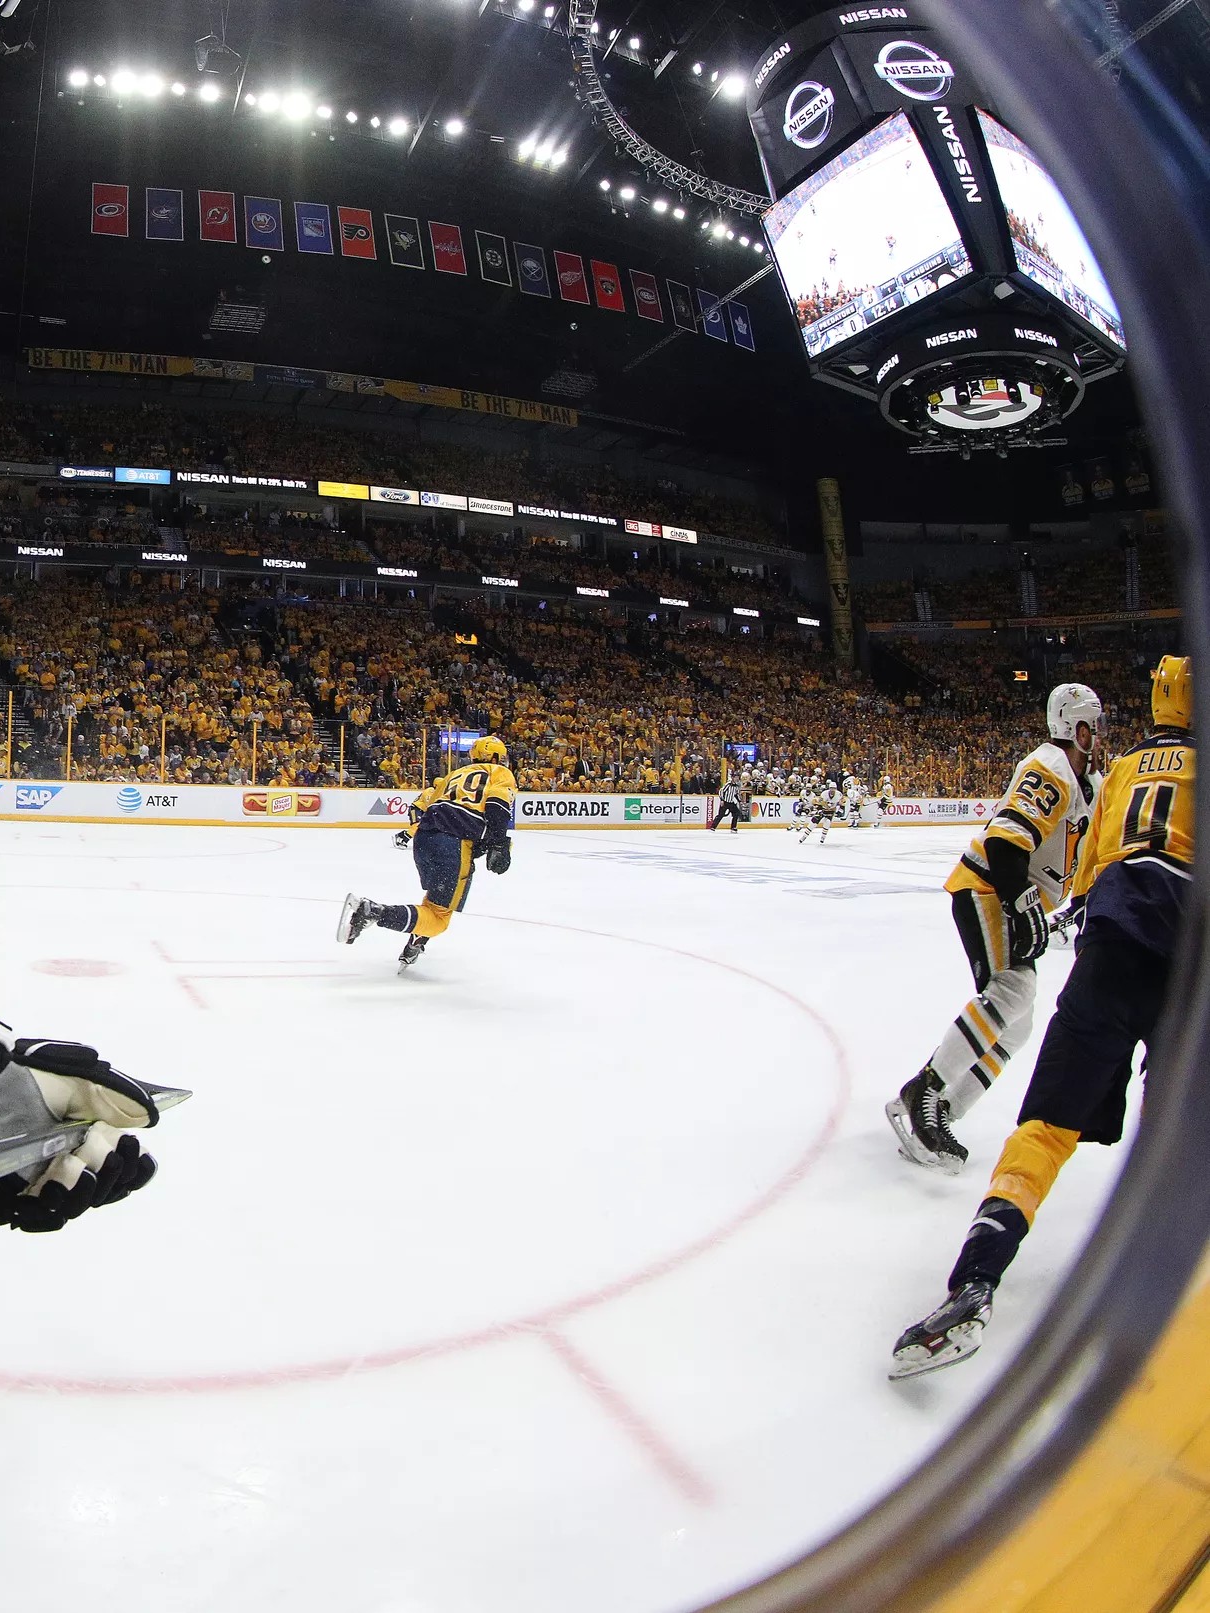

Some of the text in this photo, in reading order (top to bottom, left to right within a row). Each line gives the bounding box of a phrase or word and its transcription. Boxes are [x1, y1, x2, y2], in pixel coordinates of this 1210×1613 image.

[839, 7, 907, 25] NISSAN
[754, 42, 792, 89] NISSAN
[884, 63, 946, 76] NISSAN
[788, 95, 829, 134] NISSAN
[933, 106, 982, 203] NISSAN
[905, 256, 942, 281] PENGUINS
[913, 285, 921, 298] 1
[871, 299, 897, 319] 12:14
[820, 306, 855, 332] PREDATORS
[850, 319, 857, 333] 0
[926, 328, 978, 348] NISSAN
[1014, 328, 1058, 347] NISSAN
[32, 350, 168, 375] BE THE 7TH MAN
[460, 392, 479, 410] BE
[485, 395, 511, 415] THE
[516, 400, 537, 418] 7TH
[540, 405, 571, 425] MAN
[138, 471, 160, 480] AT&T
[177, 472, 229, 484] NISSAN
[384, 490, 405, 500] Ford
[470, 500, 512, 513] BRIDGESTONE
[518, 505, 559, 519] NISSAN
[17, 546, 63, 557] NISSAN
[142, 552, 188, 562] NISSAN
[263, 558, 306, 569] NISSAN
[377, 567, 418, 578] NISSAN
[482, 576, 519, 587] NISSAN
[576, 586, 609, 598] NISSAN
[660, 597, 689, 607] NISSAN
[733, 607, 759, 617] NISSAN
[797, 617, 821, 627] NISSAN
[1163, 684, 1170, 698] 4
[1137, 750, 1185, 774] ELLIS
[444, 769, 489, 804] 59
[1016, 770, 1061, 817] 23
[17, 789, 51, 806] SAP
[146, 795, 178, 807] AT&T
[275, 797, 290, 805] Oscar
[522, 800, 610, 817] GATORADE
[628, 801, 700, 815] enterprise
[1120, 780, 1179, 851] 4
